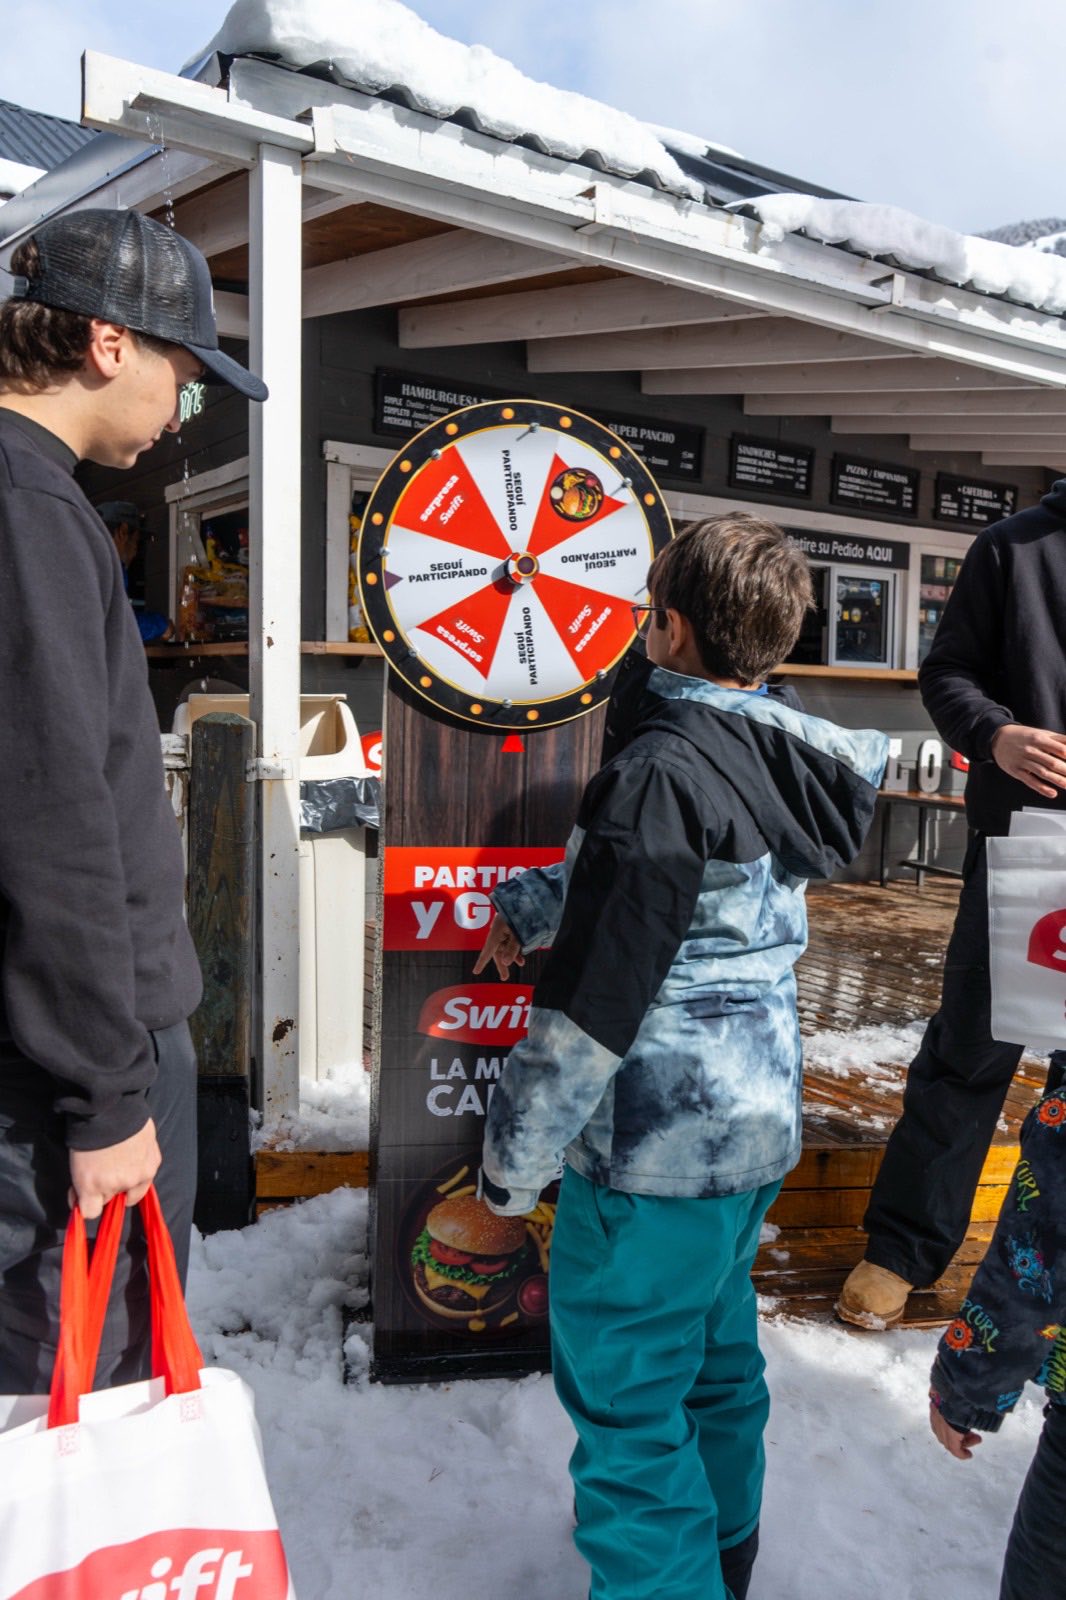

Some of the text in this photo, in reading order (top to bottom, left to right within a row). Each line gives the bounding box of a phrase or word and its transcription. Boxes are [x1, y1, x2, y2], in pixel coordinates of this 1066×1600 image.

[608, 423, 676, 444] SUPER PANCHO
[420, 475, 459, 522] sorpresa
[501, 449, 518, 531] PARTICIPANDO
[513, 472, 526, 505] SEGUÍ
[440, 495, 464, 525] Swift
[430, 559, 463, 571] SEGUÍ
[561, 548, 637, 563] PARTICIPANDO
[585, 560, 616, 572] SEGUÍ
[818, 543, 830, 555] su
[831, 541, 864, 559] Pedido
[866, 545, 893, 562] AQUI
[409, 568, 487, 582] PARTICIPANDO
[455, 620, 485, 643] Swift
[568, 604, 592, 634] Swift
[575, 607, 612, 652] sorpresa
[436, 625, 483, 663] sorpresa
[514, 632, 527, 664] SEGUÍ
[522, 607, 538, 685] PARTICIPANDO
[414, 866, 551, 888] PARTI
[411, 901, 444, 939] y
[430, 1058, 467, 1080] LA
[426, 1084, 496, 1117] CA
